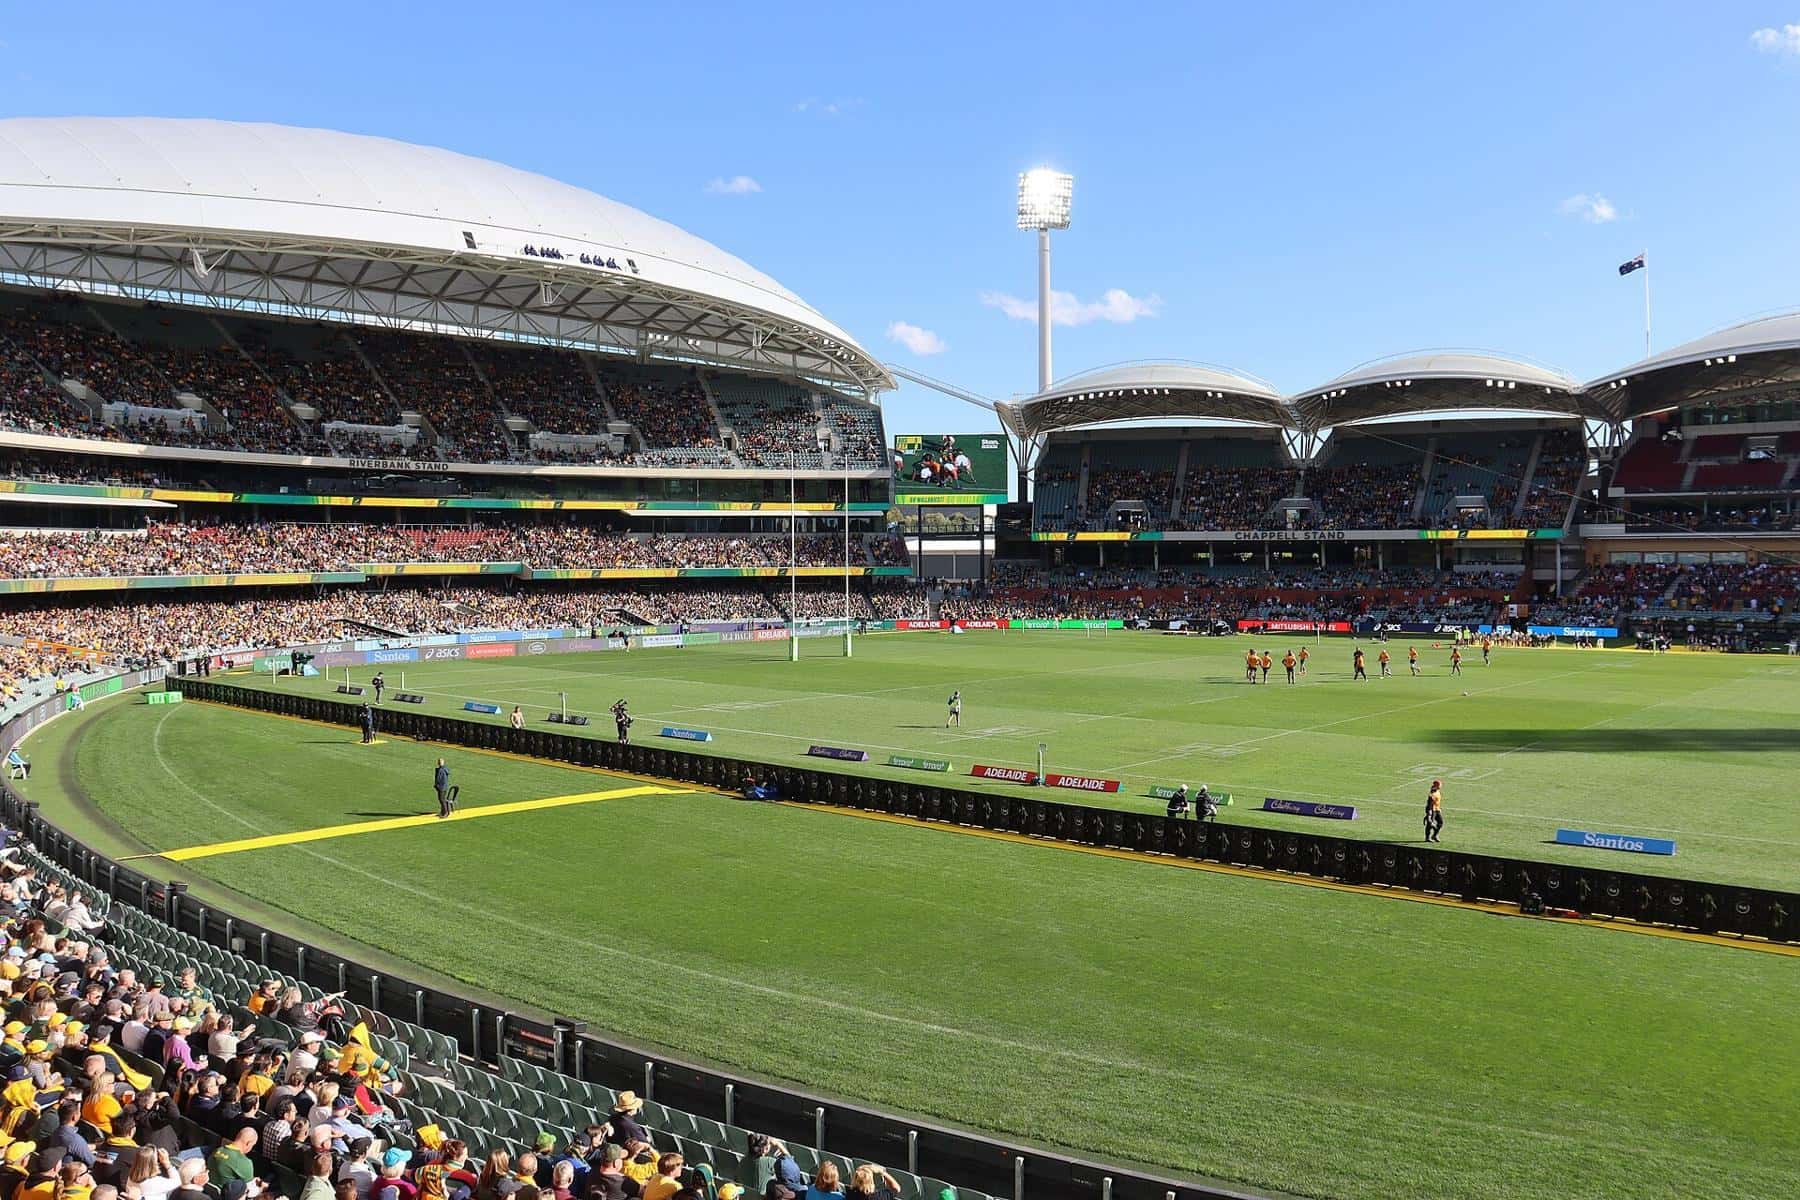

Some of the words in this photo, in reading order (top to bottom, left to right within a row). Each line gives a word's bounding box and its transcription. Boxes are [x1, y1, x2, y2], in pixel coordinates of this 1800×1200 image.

[349, 460, 412, 469] RIVERBANK
[415, 462, 449, 471] STAND
[1235, 531, 1297, 540] CHAPPELL
[1304, 531, 1345, 540] STAND
[908, 621, 941, 629] ADELAIDE
[1271, 623, 1310, 631] MITSUBISHI
[631, 626, 657, 635] bet365
[758, 629, 788, 639] ADELAIDE
[1563, 627, 1597, 637] Santos
[374, 651, 410, 662] Santos
[984, 767, 1027, 782] ADELAIDE
[1058, 776, 1105, 791] ADELAIDE
[1270, 799, 1301, 815] Cadbury
[1313, 803, 1345, 819] Cadbury
[1583, 832, 1644, 851] Santos
